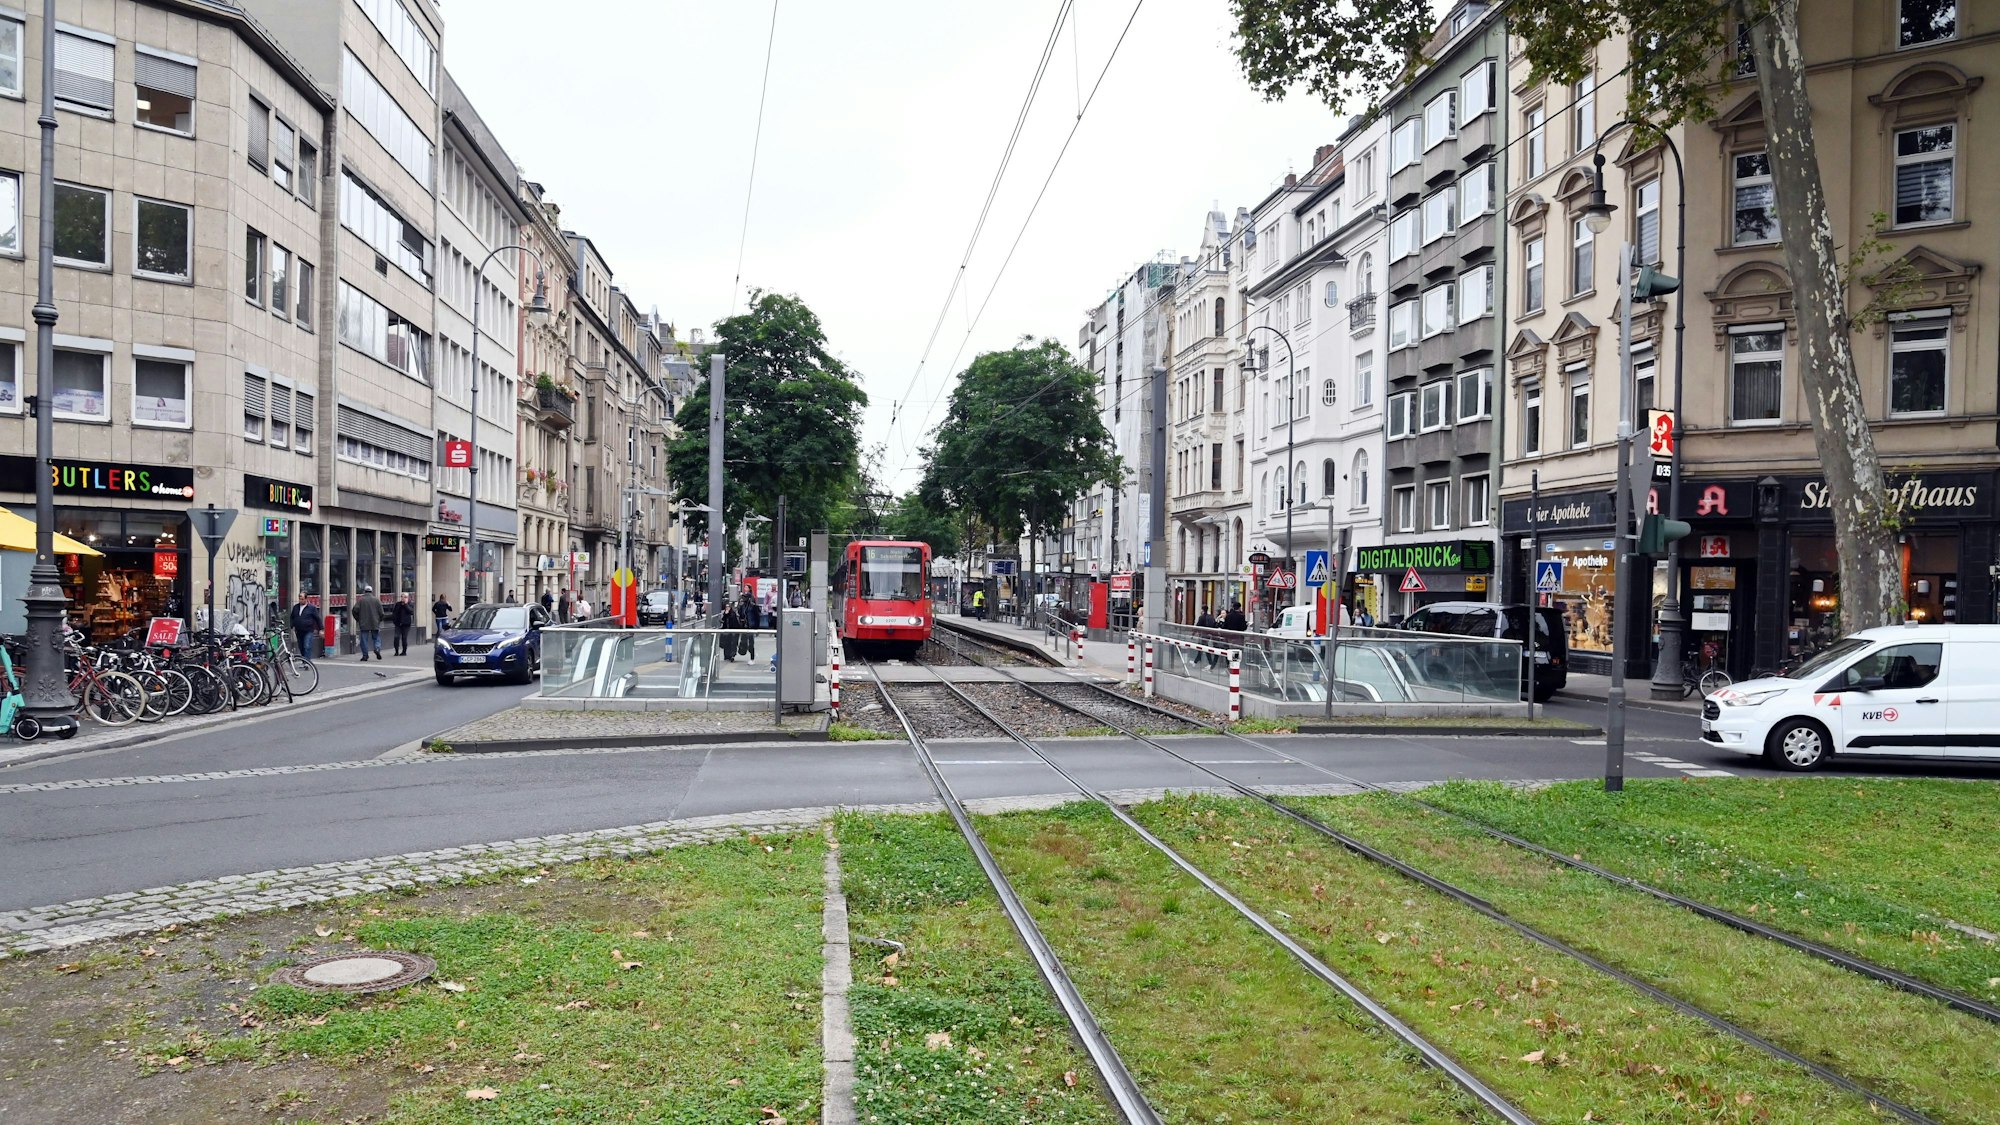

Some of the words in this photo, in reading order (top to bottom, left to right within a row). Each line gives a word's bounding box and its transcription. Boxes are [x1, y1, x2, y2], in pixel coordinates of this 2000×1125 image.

[52, 465, 151, 492] BUTLERS
[269, 483, 302, 507] BUTLERS
[1550, 502, 1591, 525] Apotheke
[426, 536, 457, 546] BUTLERS
[800, 539, 805, 547] 3
[563, 554, 569, 562] C
[867, 549, 876, 559] 16
[1360, 545, 1452, 570] DIGITALDRUCK
[1572, 554, 1608, 570] Apotheke
[1285, 576, 1294, 585] 30
[152, 632, 174, 640] SALE
[1862, 711, 1882, 720] KVB
